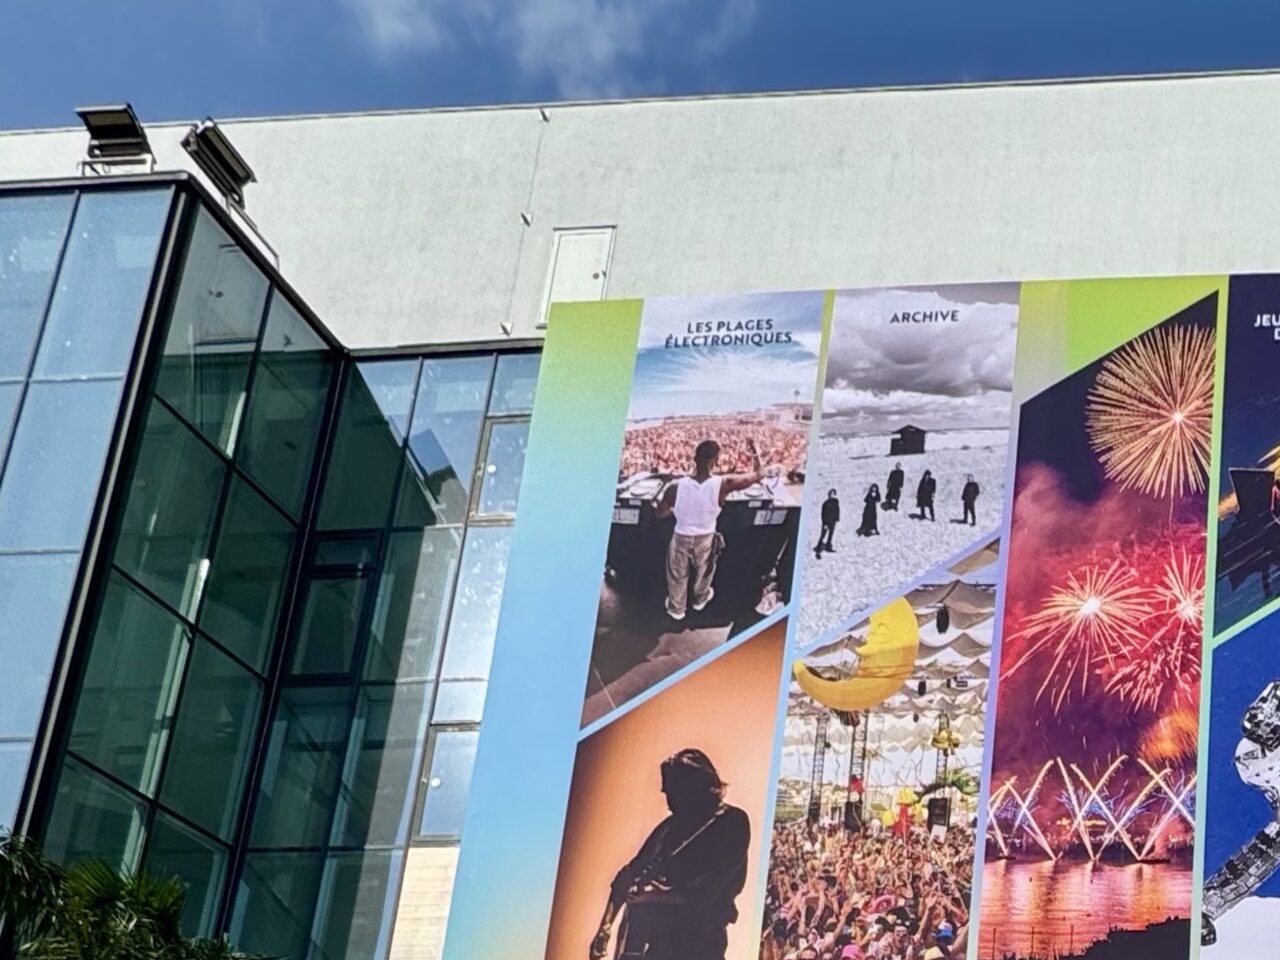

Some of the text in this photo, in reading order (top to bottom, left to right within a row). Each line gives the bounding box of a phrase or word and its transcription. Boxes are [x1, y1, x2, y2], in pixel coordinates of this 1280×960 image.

[890, 310, 960, 323] ARCHIVE
[687, 318, 773, 333] LES PLAGES
[665, 332, 792, 349] ÉLECTRONIQUES
